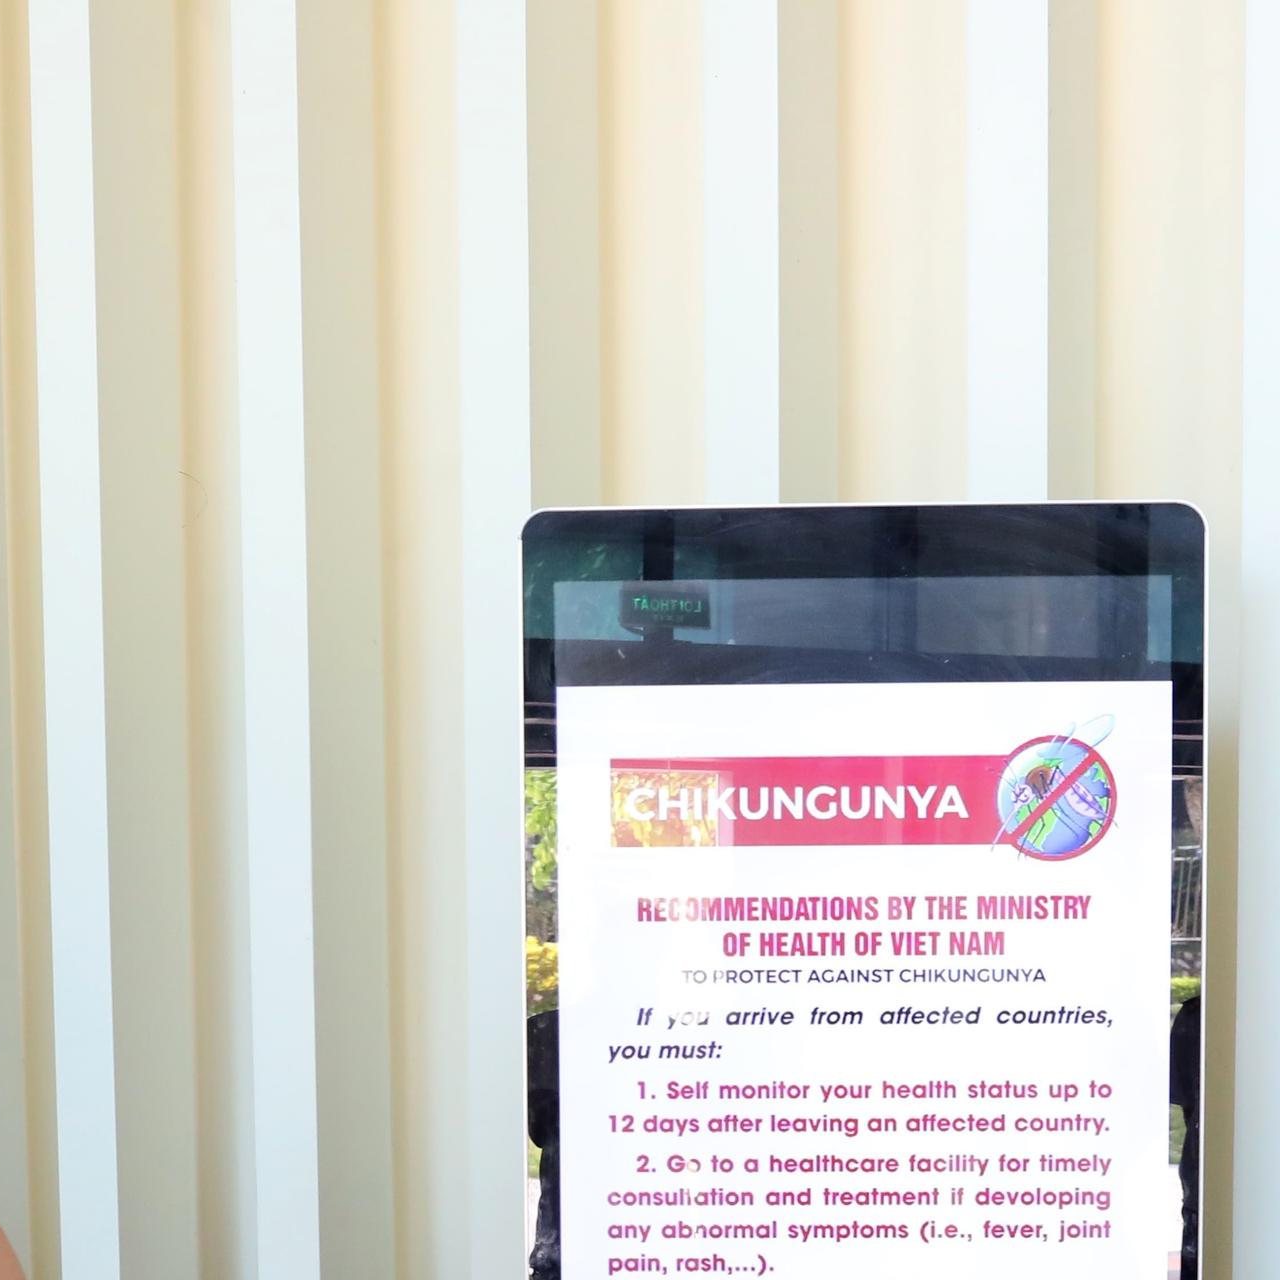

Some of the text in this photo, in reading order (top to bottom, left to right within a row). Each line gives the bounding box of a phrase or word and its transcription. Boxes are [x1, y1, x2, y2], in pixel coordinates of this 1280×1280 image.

[626, 785, 970, 821] CHIKUNGUNYA
[636, 894, 1092, 923] RECOMMENDATIONS BY THE MINISTRY
[722, 930, 1006, 958] OF HEALTH OF VIET NAM
[681, 968, 1047, 985] TO PROTECT AGAINST CHIKUNGUNYA
[635, 1005, 1113, 1031] If you arrive from affected countries,
[608, 1040, 723, 1065] you must:
[636, 1079, 1113, 1104] 1. Self monitor your health status up to
[608, 1113, 1110, 1138] 12 days after leaving an affected country.
[635, 1153, 1113, 1177] 2. Go to a healthcare facility for timely
[606, 1187, 1111, 1212] consultation and treatment if devoloping
[607, 1219, 1112, 1244] any abnormal symptoms (i.e., fever, joint
[607, 1253, 668, 1277] pain,
